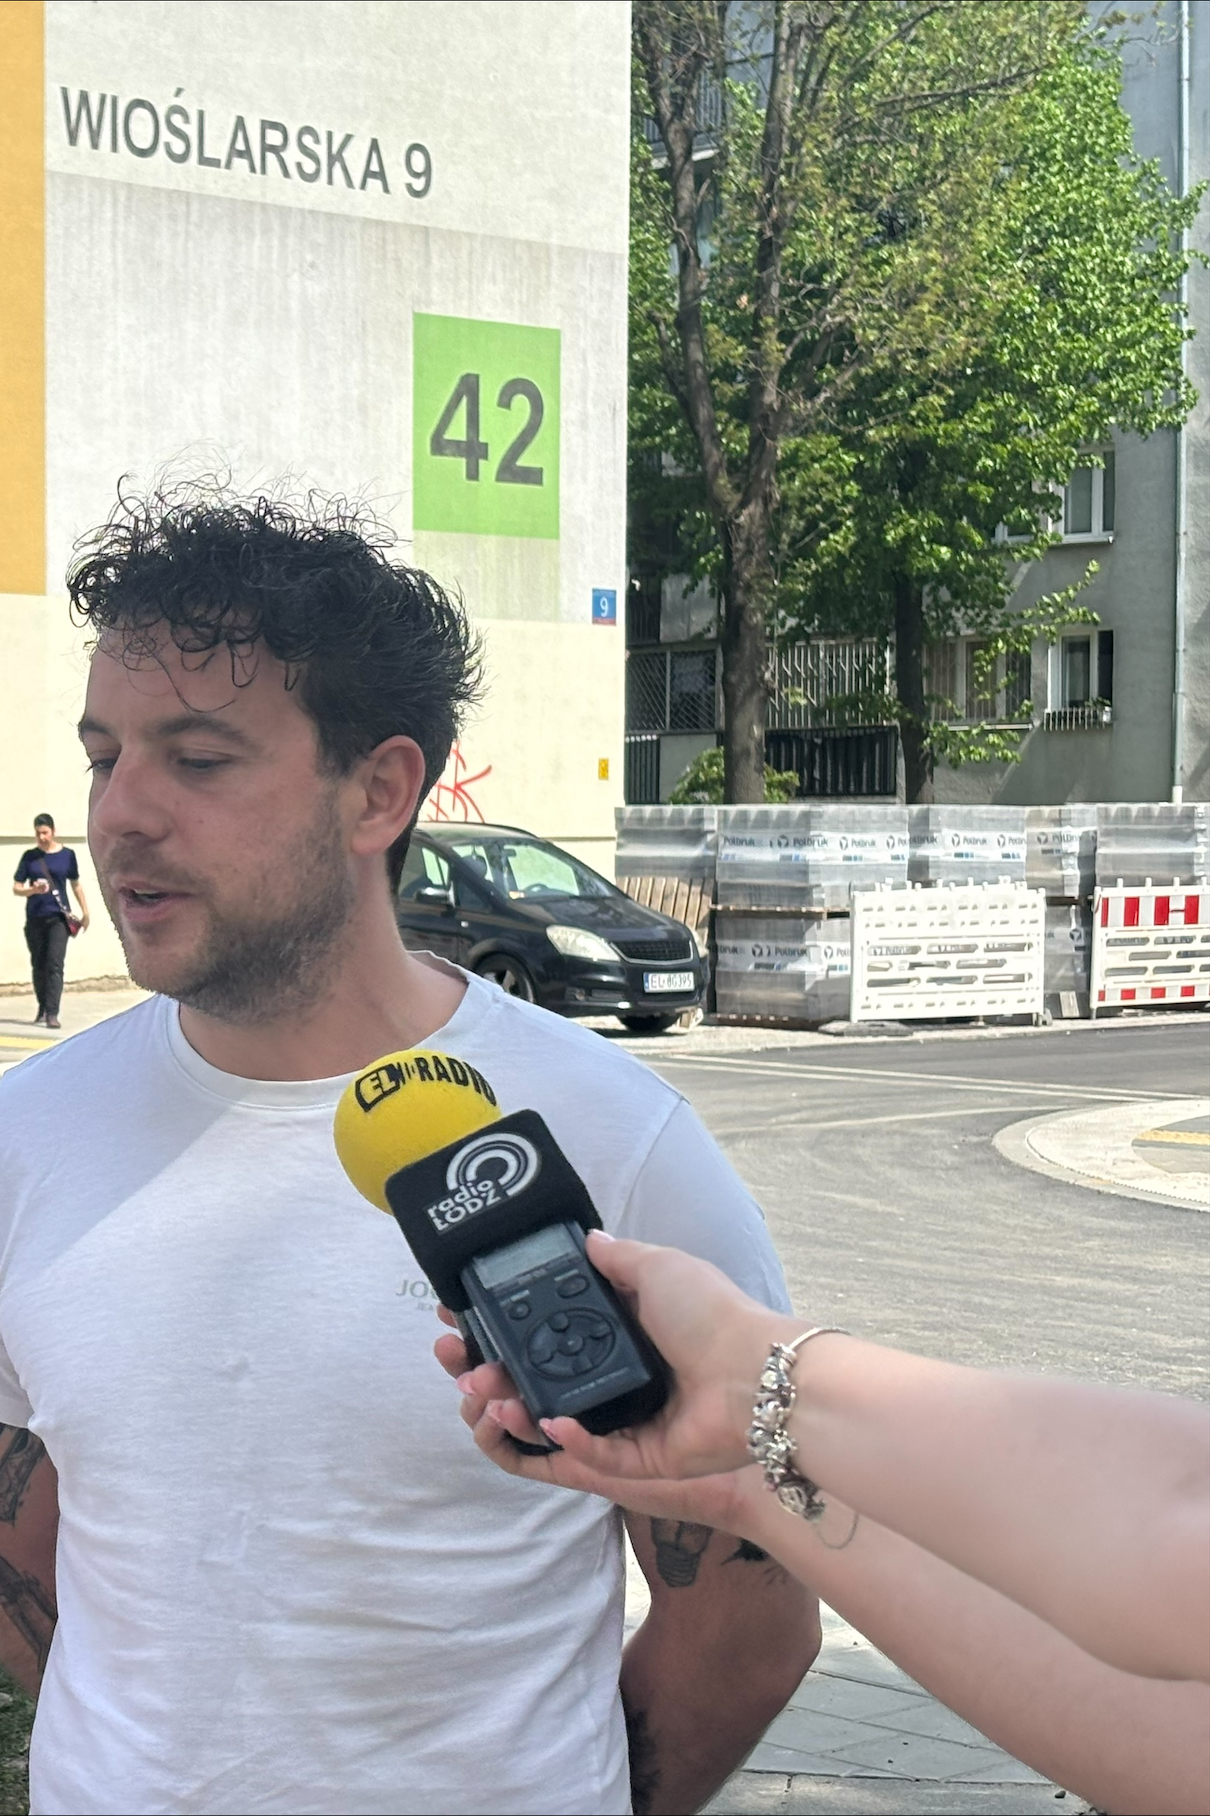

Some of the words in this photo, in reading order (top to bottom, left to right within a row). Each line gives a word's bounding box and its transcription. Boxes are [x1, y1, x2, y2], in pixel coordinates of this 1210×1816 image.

[60, 86, 391, 195] WIOŚLARSKA
[404, 142, 433, 199] 9
[429, 372, 544, 487] 42
[599, 596, 608, 618] 9
[414, 1055, 497, 1107] RADIO
[427, 1180, 494, 1218] radio
